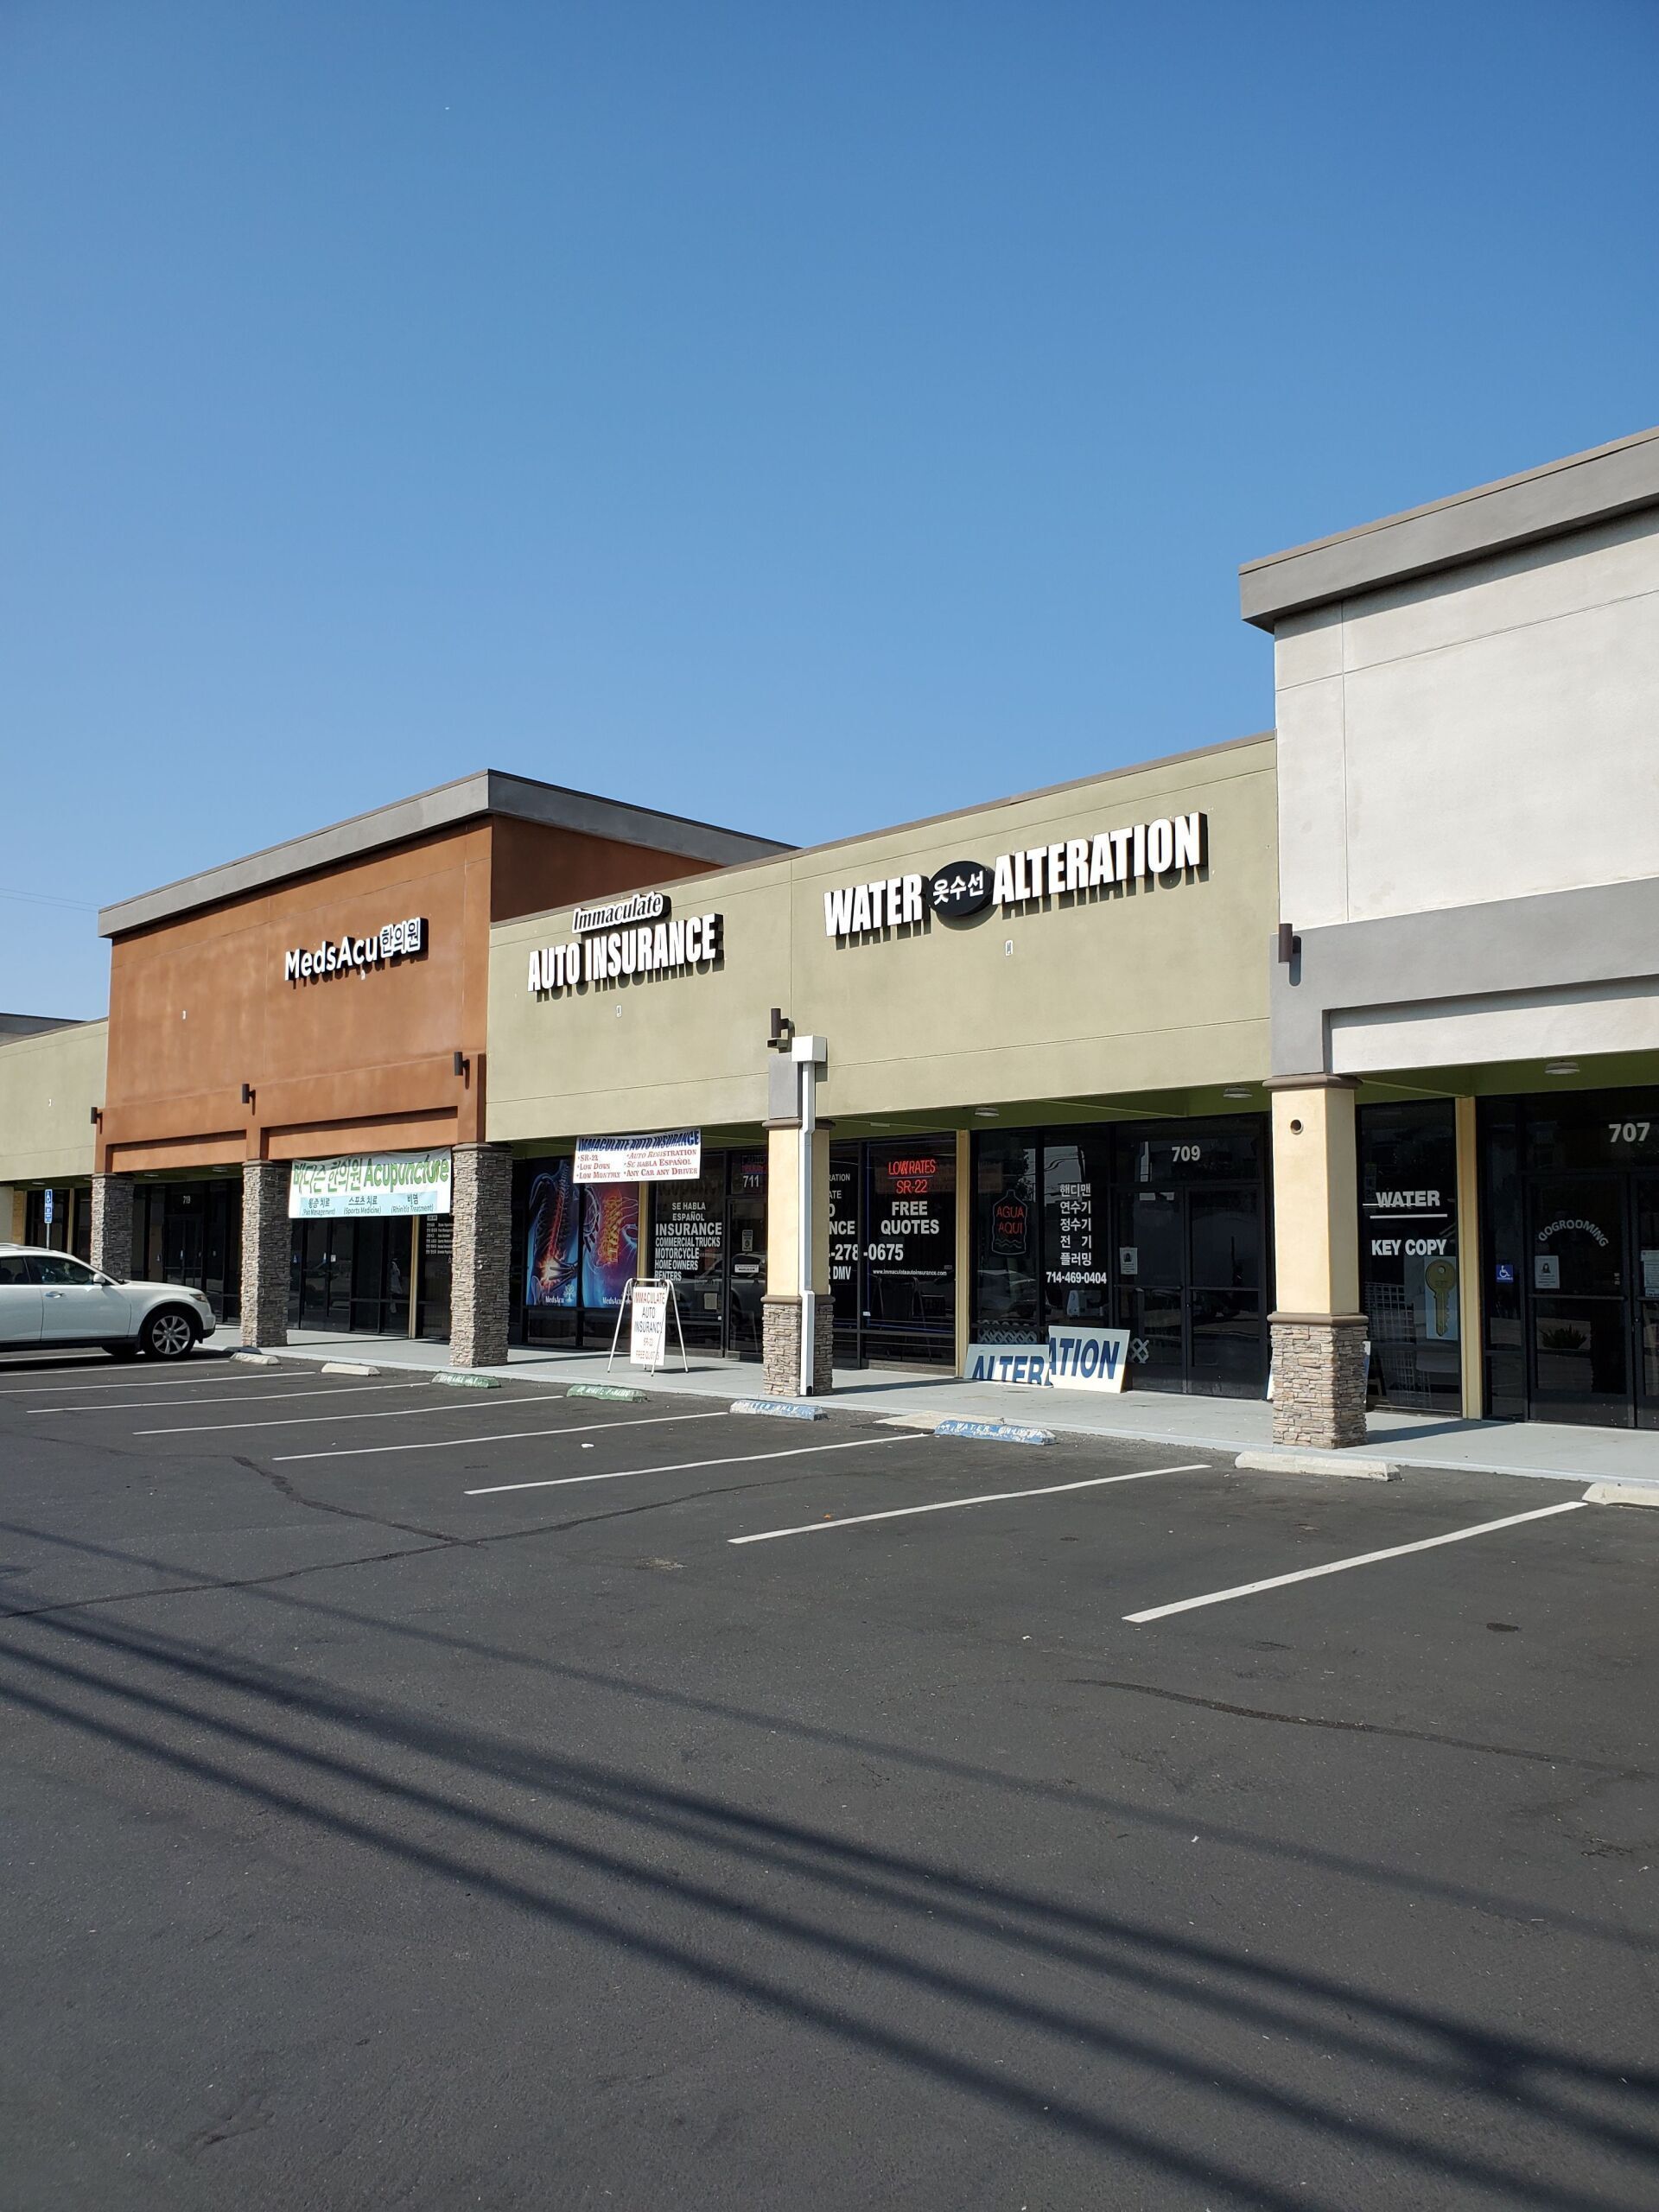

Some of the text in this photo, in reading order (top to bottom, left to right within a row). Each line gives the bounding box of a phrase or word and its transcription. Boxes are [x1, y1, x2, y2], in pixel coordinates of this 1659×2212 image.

[992, 811, 1200, 906] ALTERATION
[931, 869, 984, 906] 옷수선
[573, 893, 663, 932] Immaculate
[823, 874, 922, 938] WATER
[380, 918, 421, 958] 한의원
[284, 935, 378, 981] MedsAcu
[527, 913, 716, 992] AUTO INSURANCE
[1609, 1122, 1650, 1143] 707
[578, 1130, 700, 1152] IMMACULATE AUTO INSURANCE
[1171, 1145, 1201, 1162] 709
[363, 1154, 449, 1192] Acupuncture
[888, 1159, 937, 1175] LOW RATES
[293, 1157, 363, 1193] 메디슨 한의원
[743, 1175, 760, 1188] 711
[896, 1179, 928, 1194] SR-22
[1059, 1183, 1091, 1198] 핸디맨
[348, 1195, 378, 1205] 스포츠 치료
[671, 1202, 706, 1211] SE HABLA
[1376, 1190, 1440, 1208] WATER
[891, 1200, 928, 1216] FREE
[996, 1205, 1025, 1218] AGUA
[1059, 1200, 1092, 1215] 연수기
[672, 1211, 705, 1221] ESPAÑOL
[655, 1223, 722, 1236] INSURANCE
[880, 1219, 940, 1236] QUOTES
[998, 1221, 1023, 1235] AQUI
[1059, 1217, 1092, 1232] 정수기
[1537, 1219, 1609, 1248] DOGROOMING
[655, 1236, 721, 1247] COMMERCIAL TRUCKS
[1371, 1238, 1447, 1255] KEY COPY
[655, 1247, 700, 1259] MOTORCYCLE
[1059, 1252, 1092, 1267] 플러밍
[654, 1259, 698, 1270] HOME OWNERS
[654, 1271, 683, 1281] RENTERS
[833, 1265, 851, 1281] DMV
[1046, 1271, 1107, 1284] 714-469-0404
[545, 1295, 564, 1304] MedsAcu
[642, 1306, 656, 1319] AUTO
[957, 1422, 989, 1433] WATER
